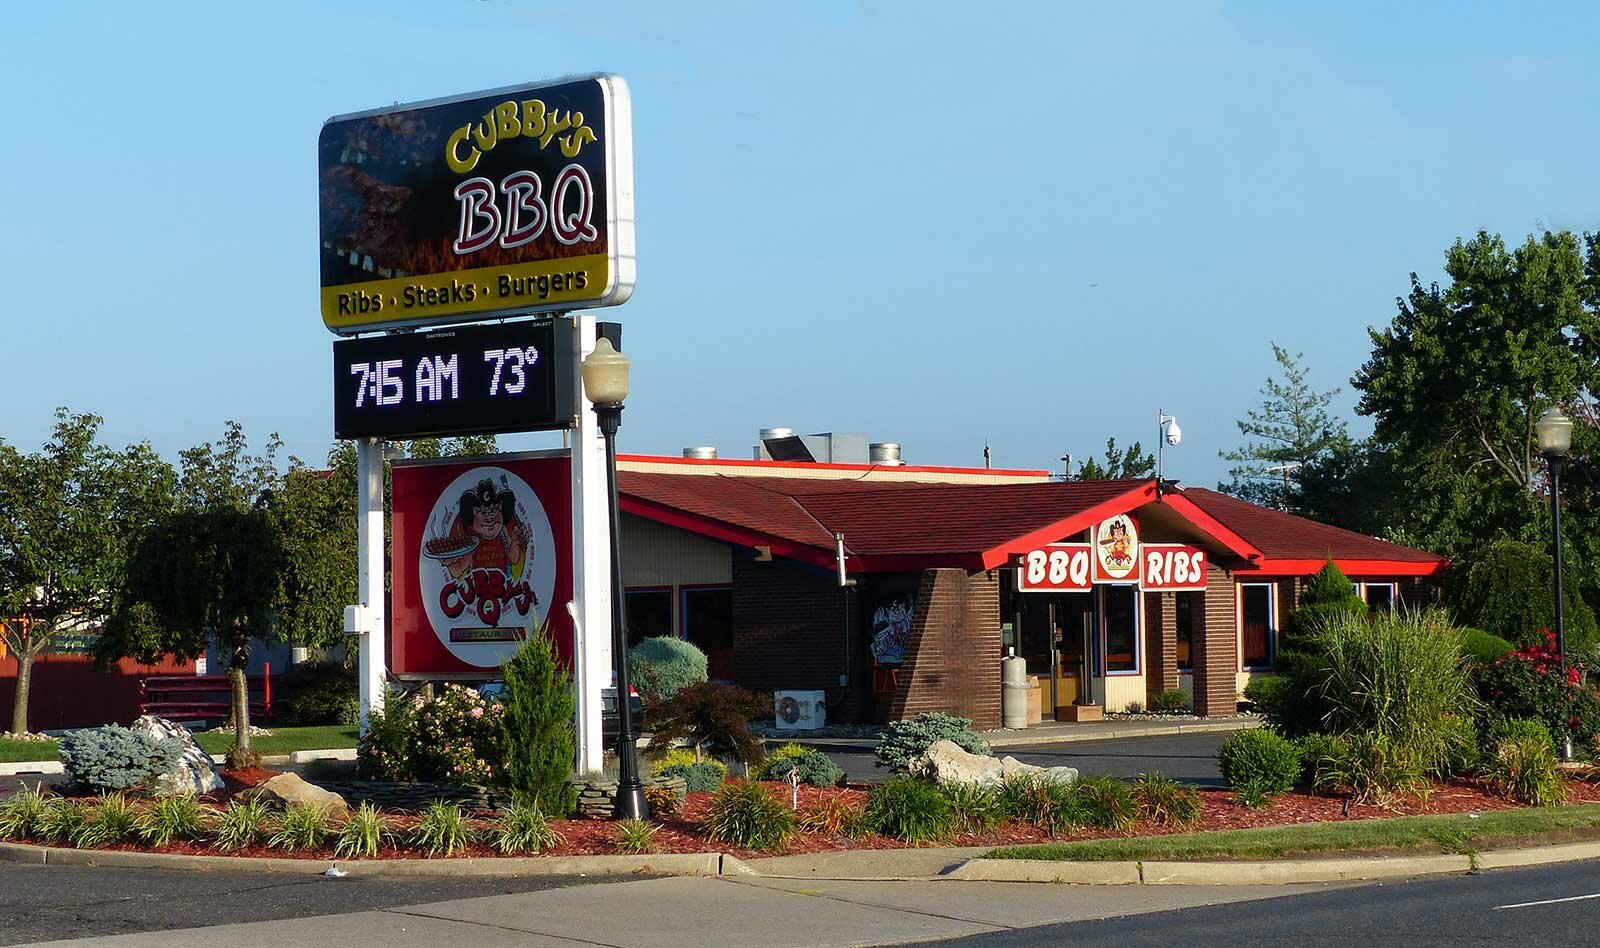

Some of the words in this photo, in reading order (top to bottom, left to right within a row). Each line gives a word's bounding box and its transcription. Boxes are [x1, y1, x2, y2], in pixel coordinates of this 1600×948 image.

[453, 163, 597, 255] BBQ
[338, 289, 384, 316] Ribs
[403, 279, 476, 309] Steaks
[498, 270, 588, 299] Burgers
[351, 359, 403, 407] 7:15
[415, 354, 459, 402] AM
[1027, 550, 1089, 587] BBQ
[1147, 551, 1204, 585] RIBS
